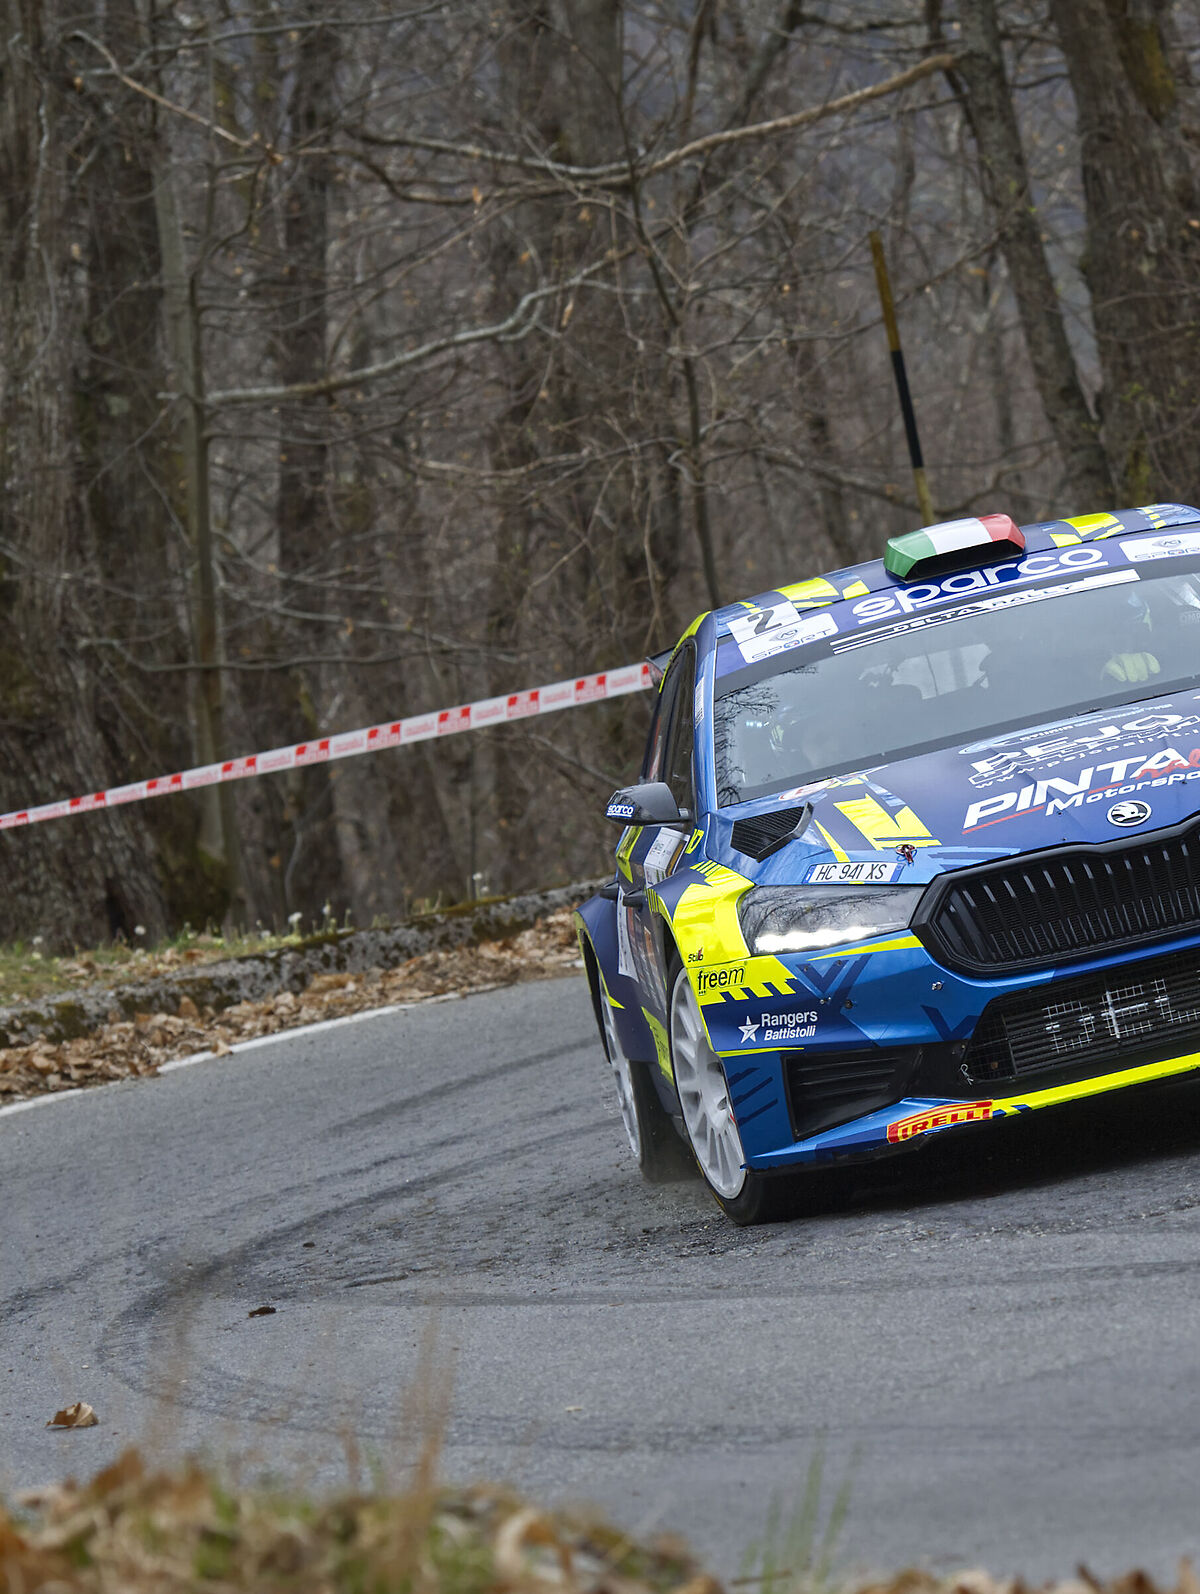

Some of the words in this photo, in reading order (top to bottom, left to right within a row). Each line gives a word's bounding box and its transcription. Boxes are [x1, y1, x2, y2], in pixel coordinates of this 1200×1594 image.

[852, 548, 1103, 613] sparco
[893, 605, 984, 633] DELTA
[990, 584, 1074, 608] RALLY
[746, 609, 782, 635] 2
[970, 714, 1184, 774] PEJO
[962, 746, 1191, 829] PINTA
[607, 804, 634, 815] sparco
[815, 864, 837, 881] HC
[838, 863, 865, 880] 941
[865, 863, 887, 880] XS
[697, 967, 745, 991] freem
[761, 1010, 818, 1028] Rangers
[763, 1025, 816, 1041] Battistolli
[887, 1100, 992, 1143] PIRELLI
